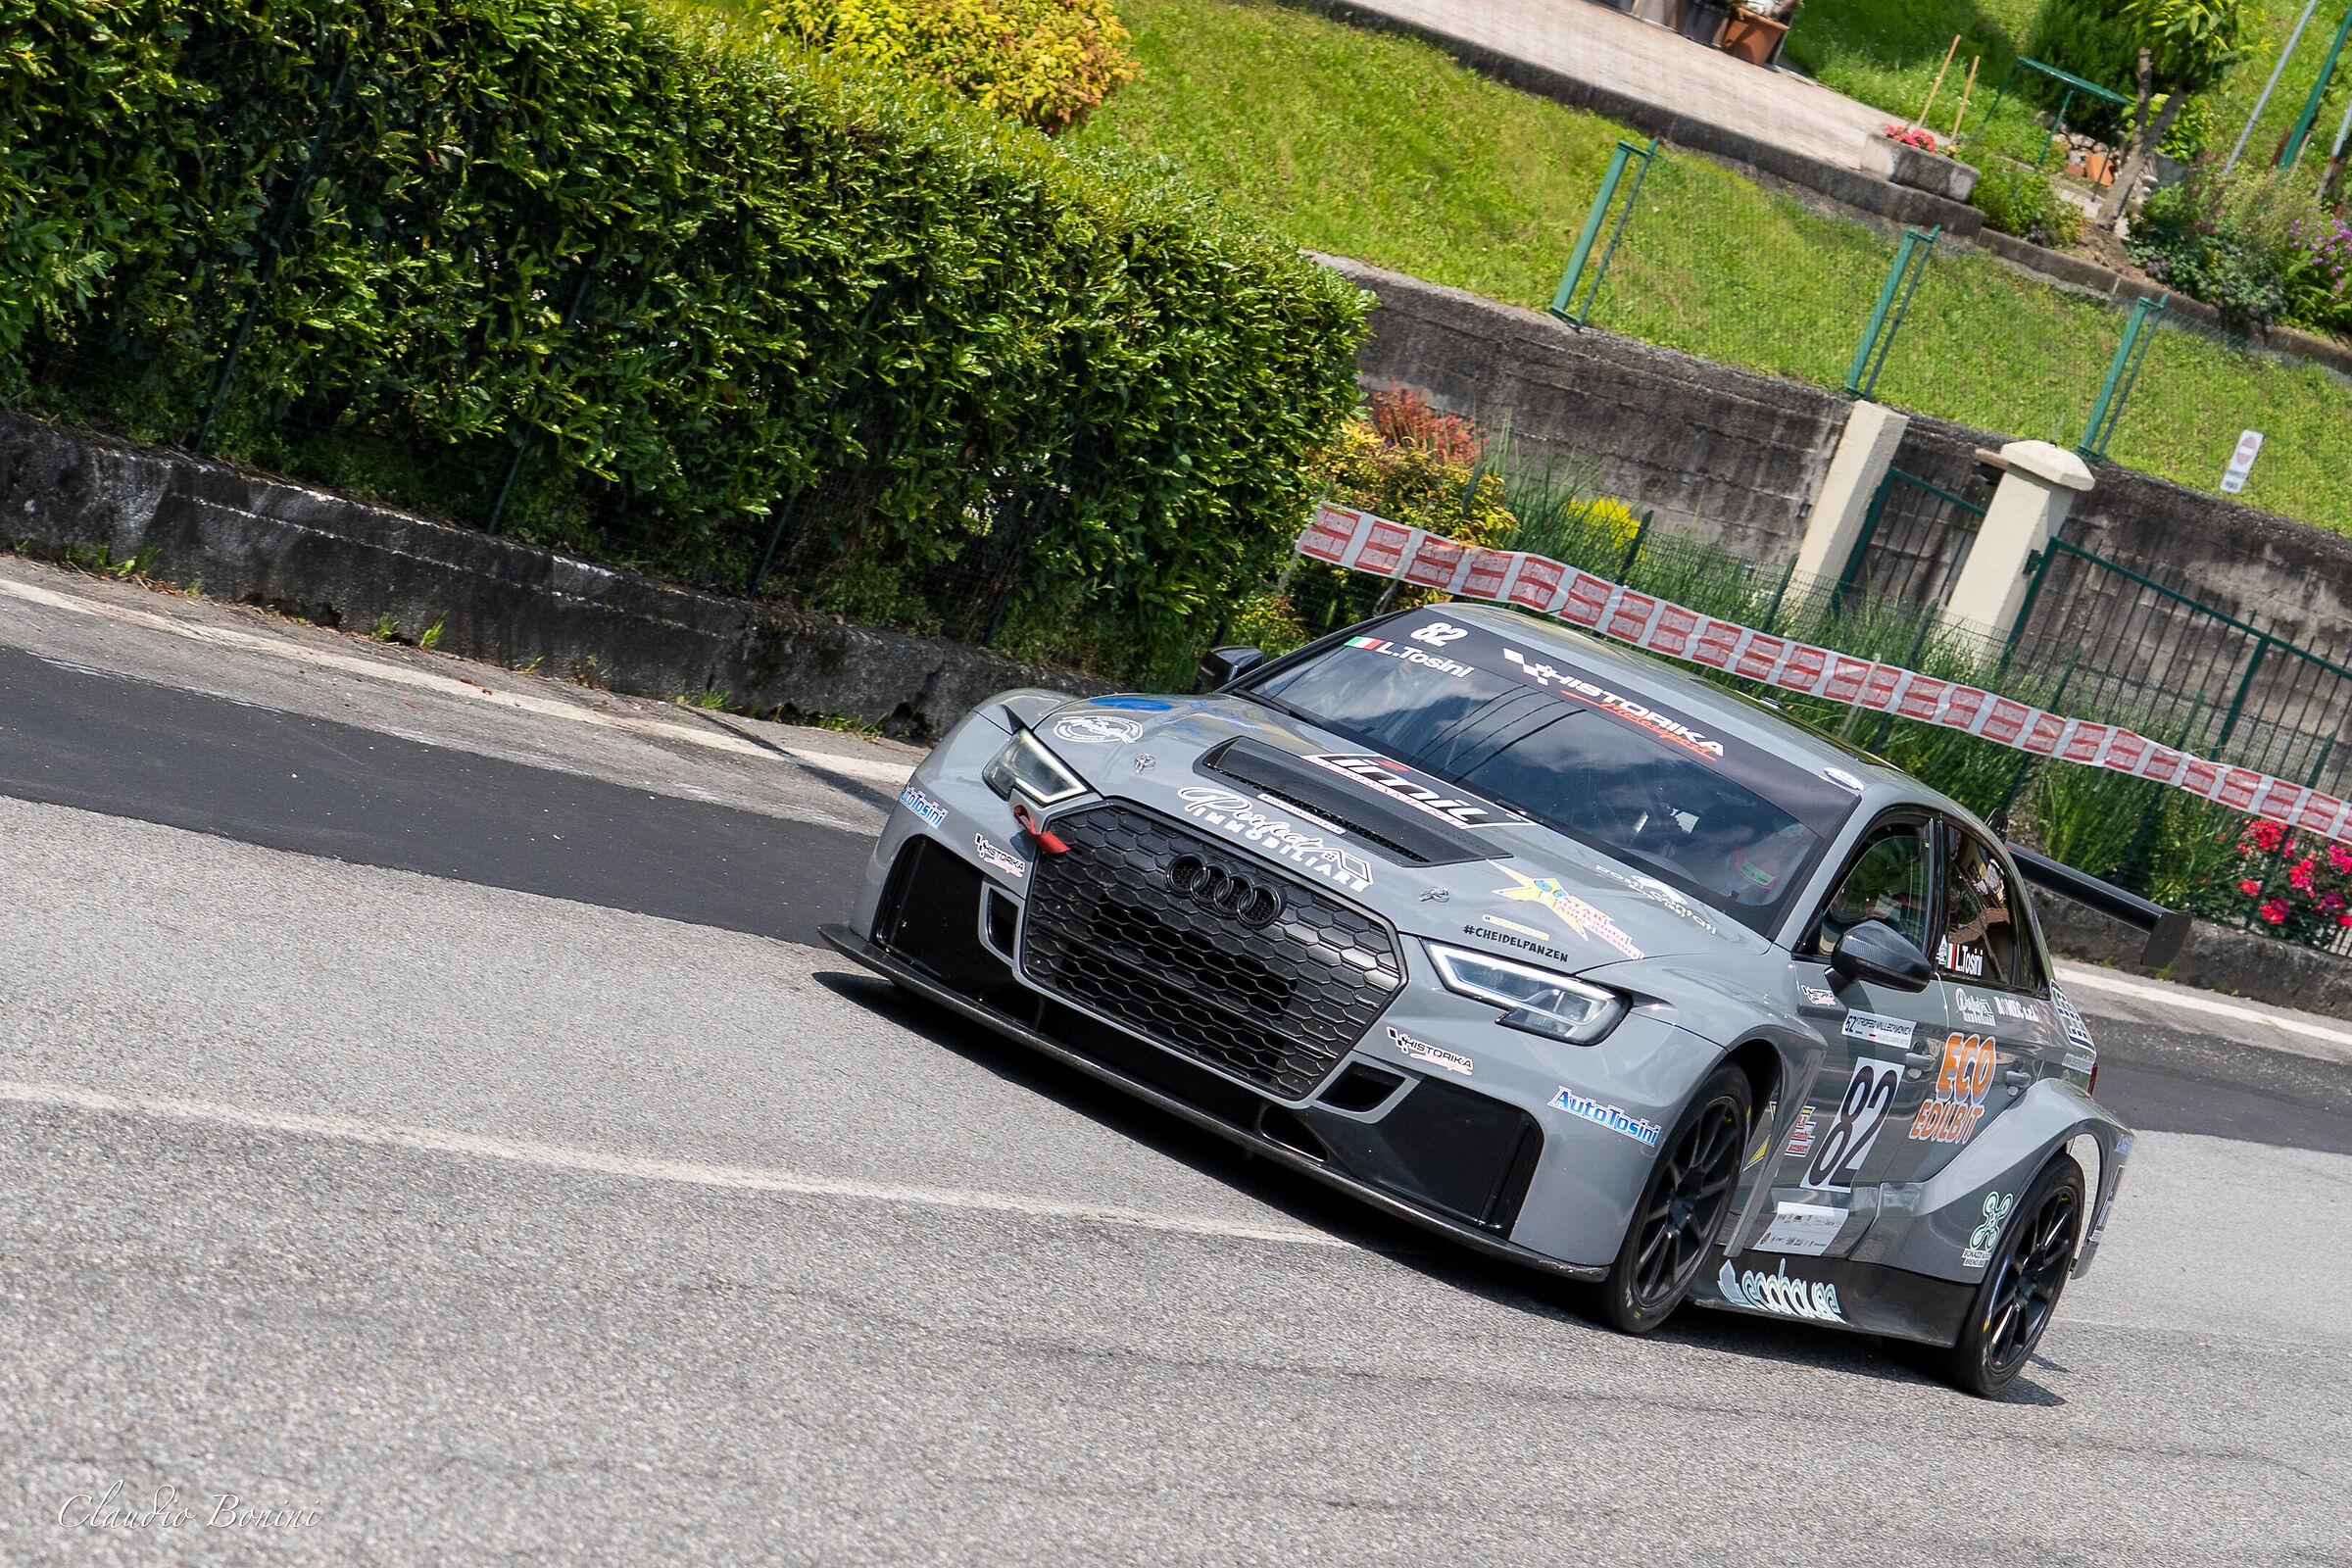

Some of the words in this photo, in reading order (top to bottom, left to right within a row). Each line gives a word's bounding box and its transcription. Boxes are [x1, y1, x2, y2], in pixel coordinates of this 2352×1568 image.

[1376, 641, 1475, 678] L.Tosini
[1410, 622, 1469, 647] 82
[1544, 668, 1724, 758] HISTORIKA
[1192, 807, 1370, 893] IMMOBILIARE
[1462, 924, 1569, 962] #CHEIDELPANZEN
[1404, 1038, 1473, 1069] HISTORIKA
[1936, 1033, 1995, 1103] ECO
[1551, 1088, 1660, 1146] AutoTosini
[1808, 1065, 1897, 1188] 82
[1909, 1100, 1984, 1145] EDILBIT
